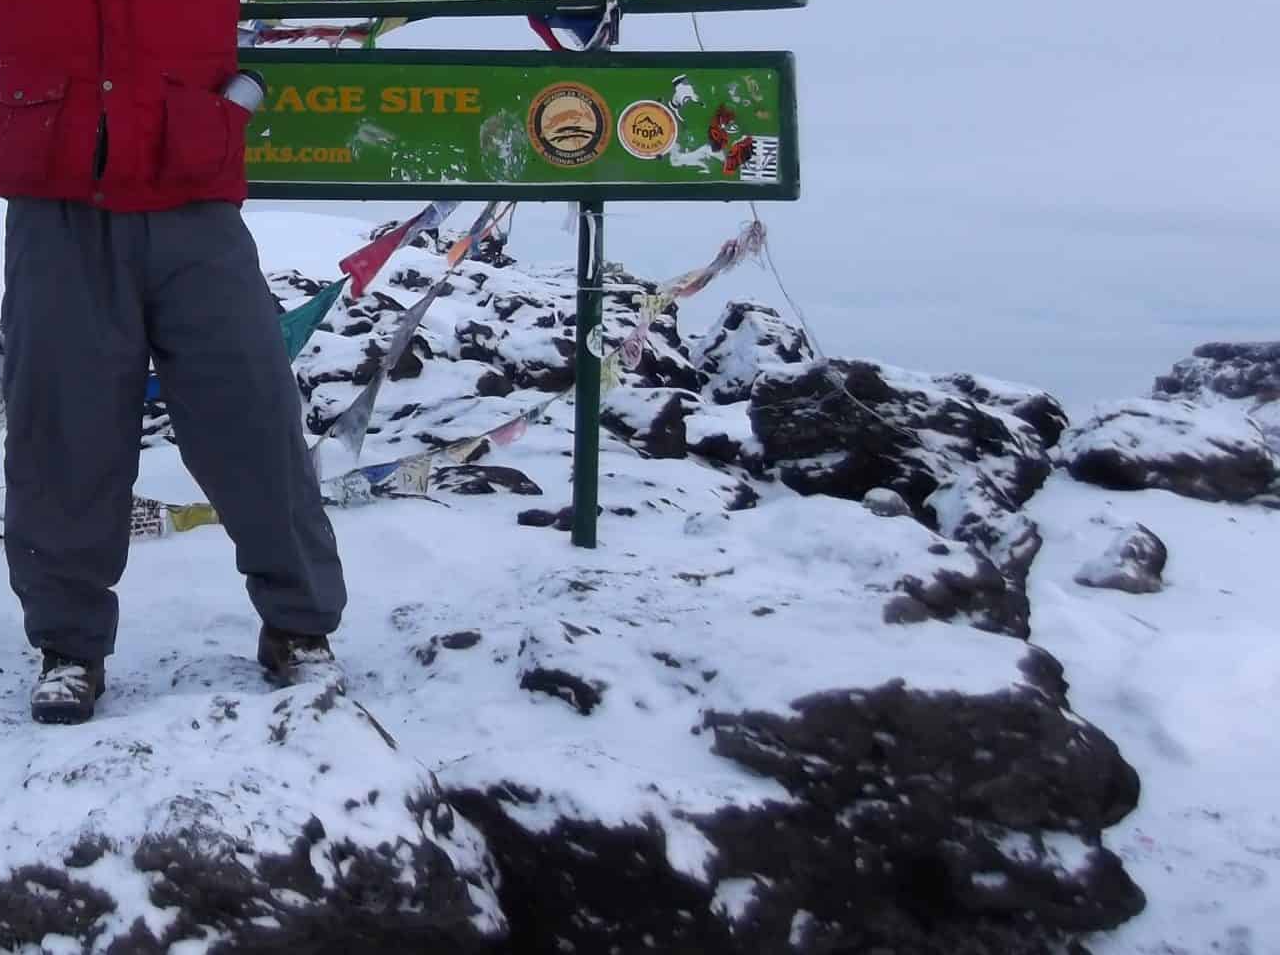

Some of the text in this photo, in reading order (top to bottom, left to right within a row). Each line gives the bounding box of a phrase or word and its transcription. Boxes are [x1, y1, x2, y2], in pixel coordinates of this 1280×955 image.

[263, 86, 481, 113] AGE SITE
[246, 142, 353, 164] arks.com
